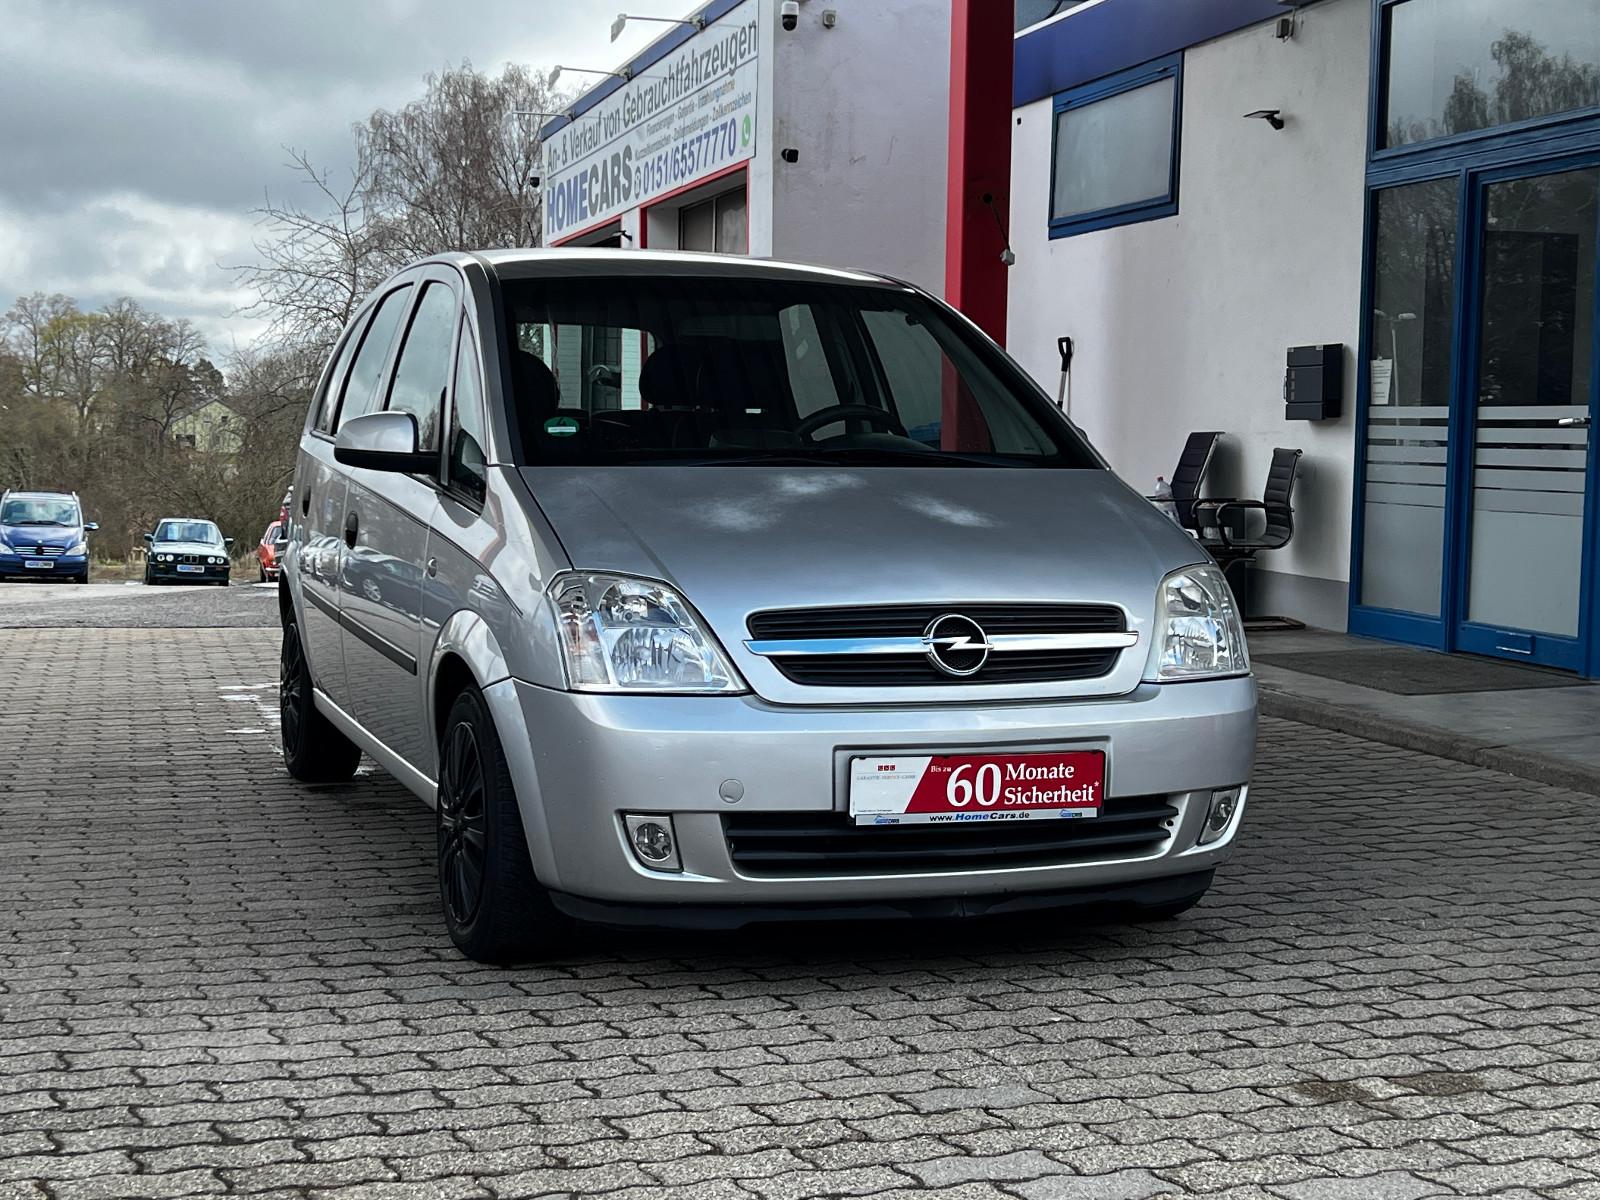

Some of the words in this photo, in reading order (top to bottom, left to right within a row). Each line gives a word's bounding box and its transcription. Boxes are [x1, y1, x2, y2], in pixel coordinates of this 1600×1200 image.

[547, 142, 561, 173] An-
[561, 133, 568, 166] &
[569, 109, 602, 158] Verkauf
[604, 108, 621, 140] von
[623, 18, 758, 128] Gebrauchtfahrzeugen
[642, 117, 737, 195] 0151/65577770
[546, 144, 633, 236] HOMECARS
[946, 763, 1002, 807] 60
[1005, 762, 1075, 781] Monate
[929, 811, 1030, 822] www.HomeCars.de
